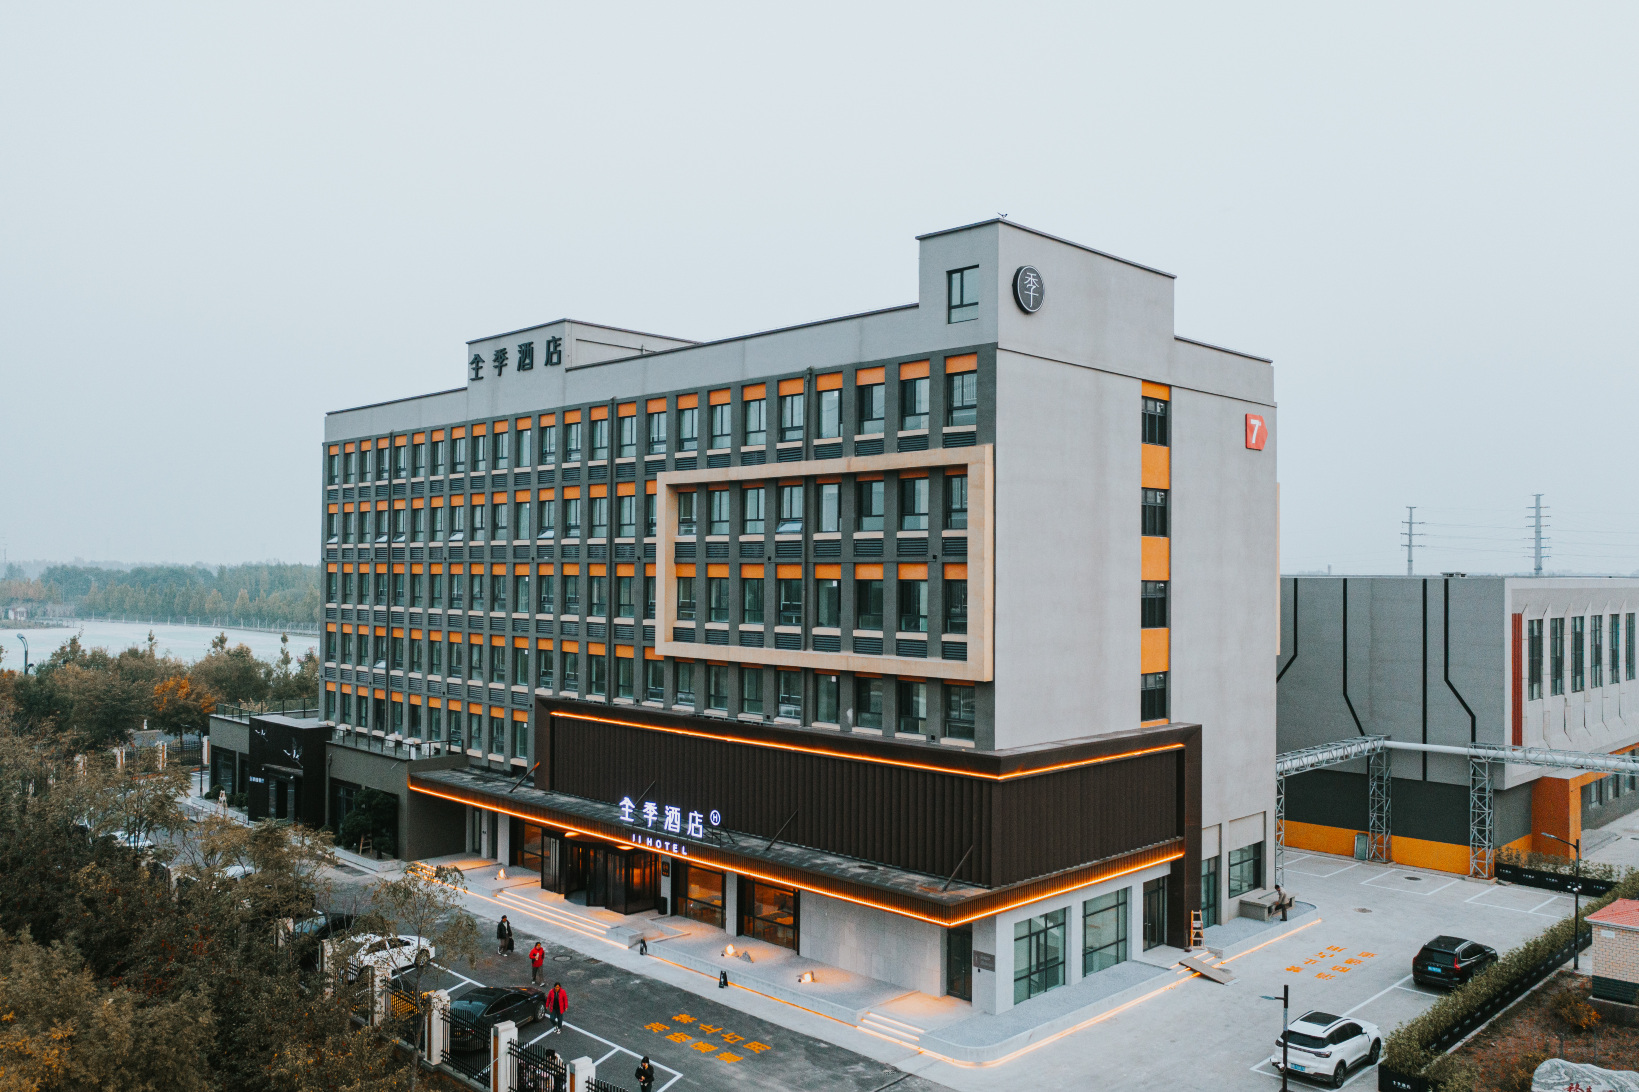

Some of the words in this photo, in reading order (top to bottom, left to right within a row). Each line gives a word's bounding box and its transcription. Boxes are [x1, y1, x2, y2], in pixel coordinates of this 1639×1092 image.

[1024, 272, 1039, 308] 季
[469, 335, 562, 381] 全季酒店
[1250, 419, 1262, 444] 7
[619, 796, 704, 838] 全季酒店
[646, 837, 688, 856] HOTEL
[643, 1021, 744, 1064] 消防通道
[671, 1013, 772, 1054] 禁止占用
